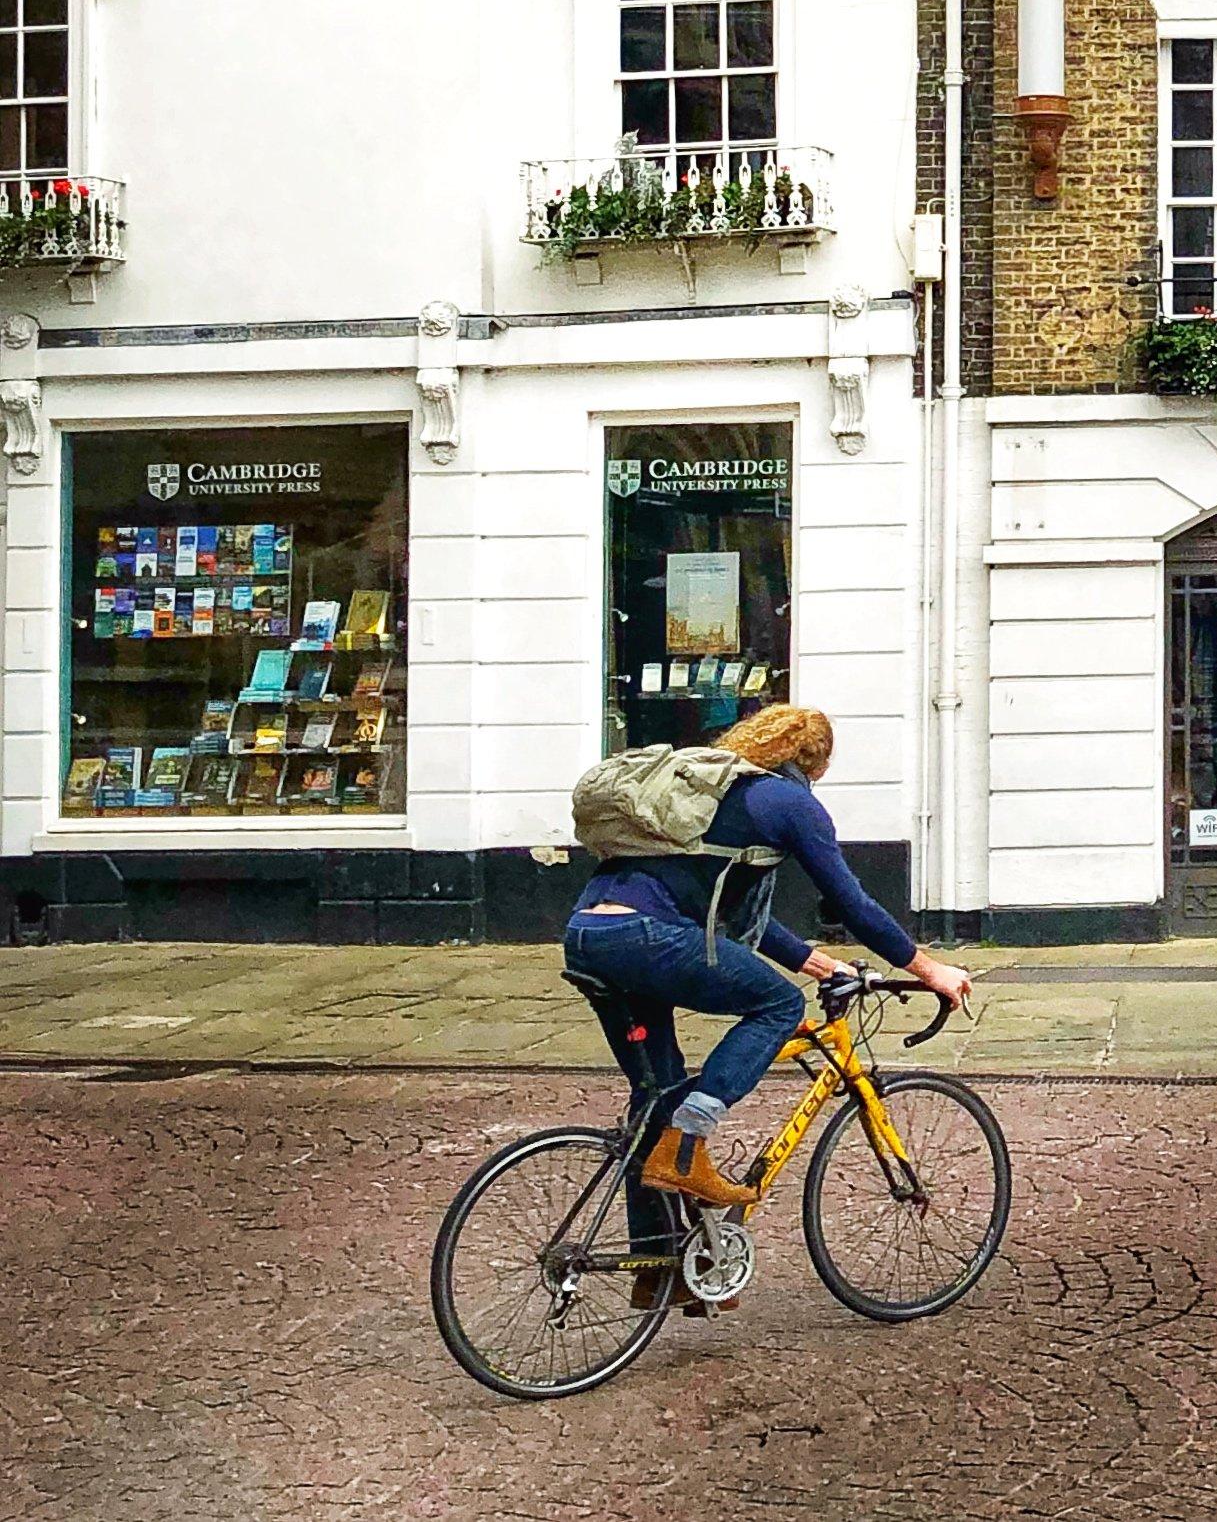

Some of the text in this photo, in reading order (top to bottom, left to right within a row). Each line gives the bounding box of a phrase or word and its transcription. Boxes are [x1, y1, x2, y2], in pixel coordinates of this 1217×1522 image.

[187, 462, 322, 483] CAMBRIDGE
[649, 458, 789, 479] CAMBRIDGE
[189, 481, 321, 496] UNIVERSITY PRESS
[651, 478, 788, 492] UNIVERSITY PRESS
